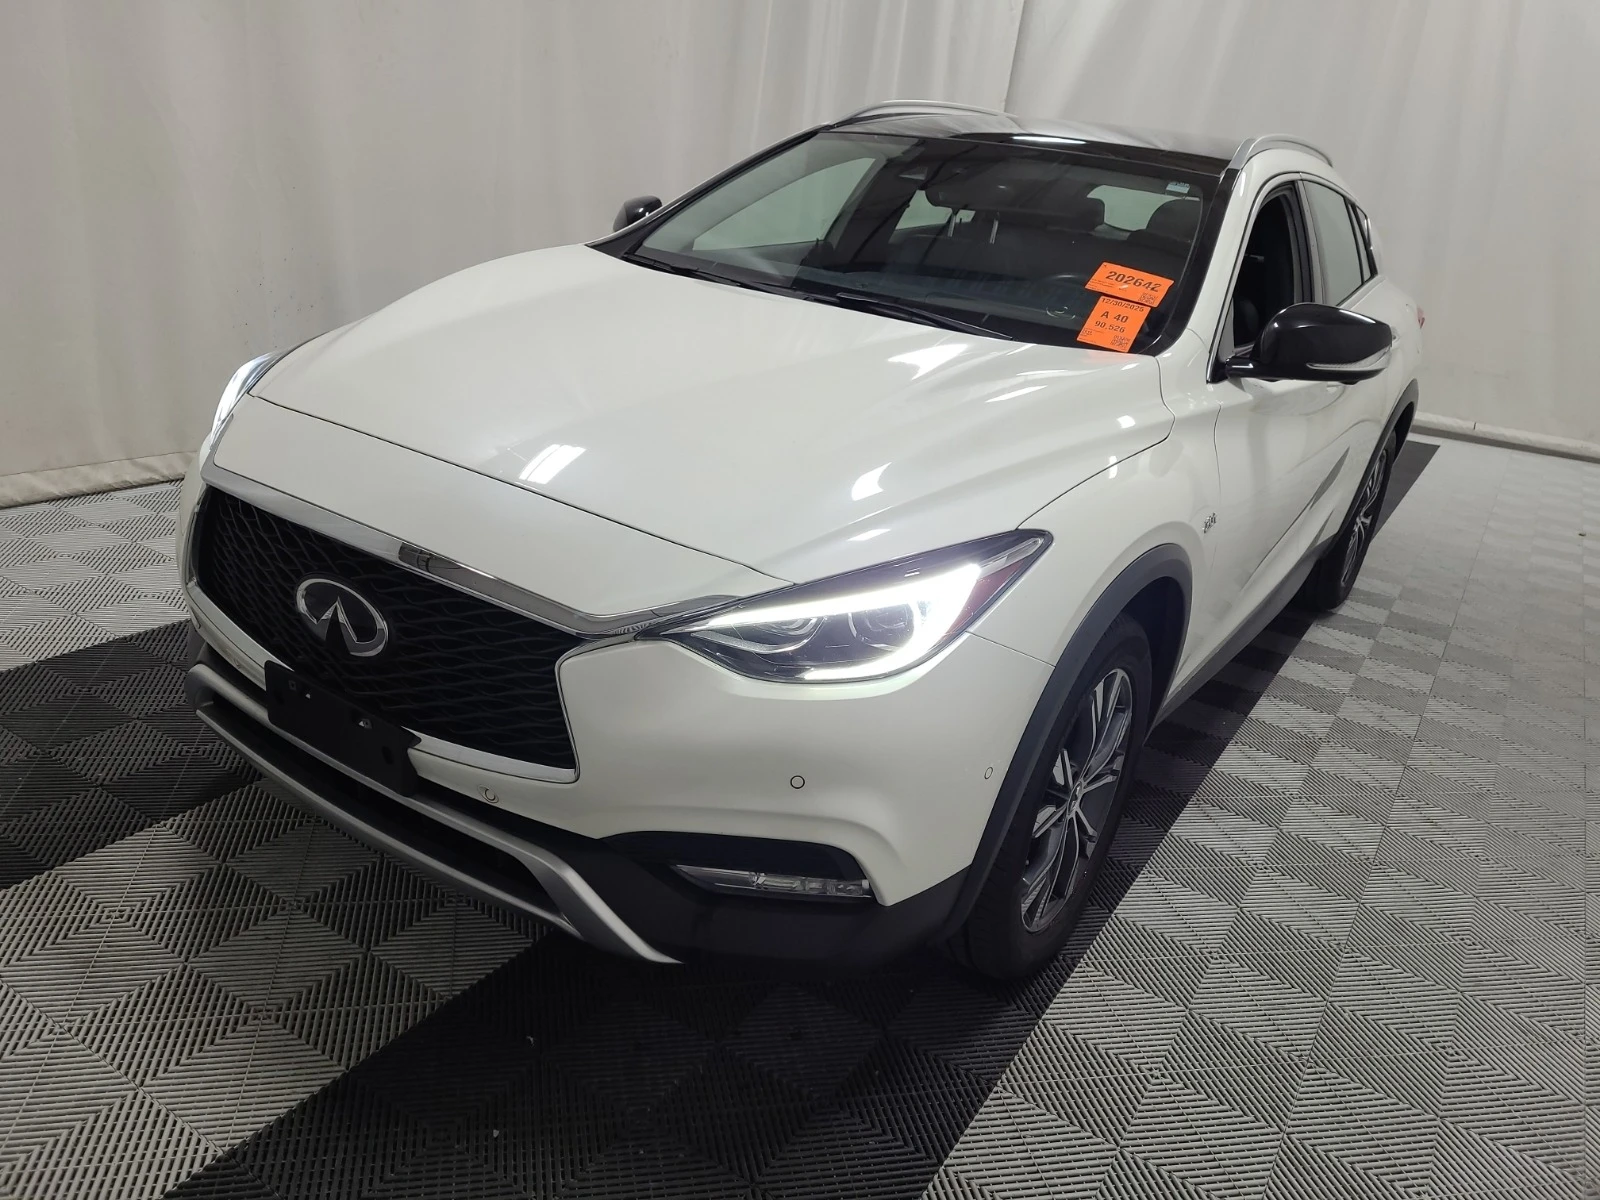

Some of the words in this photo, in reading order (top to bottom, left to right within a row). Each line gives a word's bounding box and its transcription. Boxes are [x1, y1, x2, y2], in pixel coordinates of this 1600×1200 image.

[1105, 271, 1162, 293] 202642
[1101, 297, 1145, 312] 12/30/2025
[1100, 310, 1110, 319] A
[1113, 313, 1129, 323] 40
